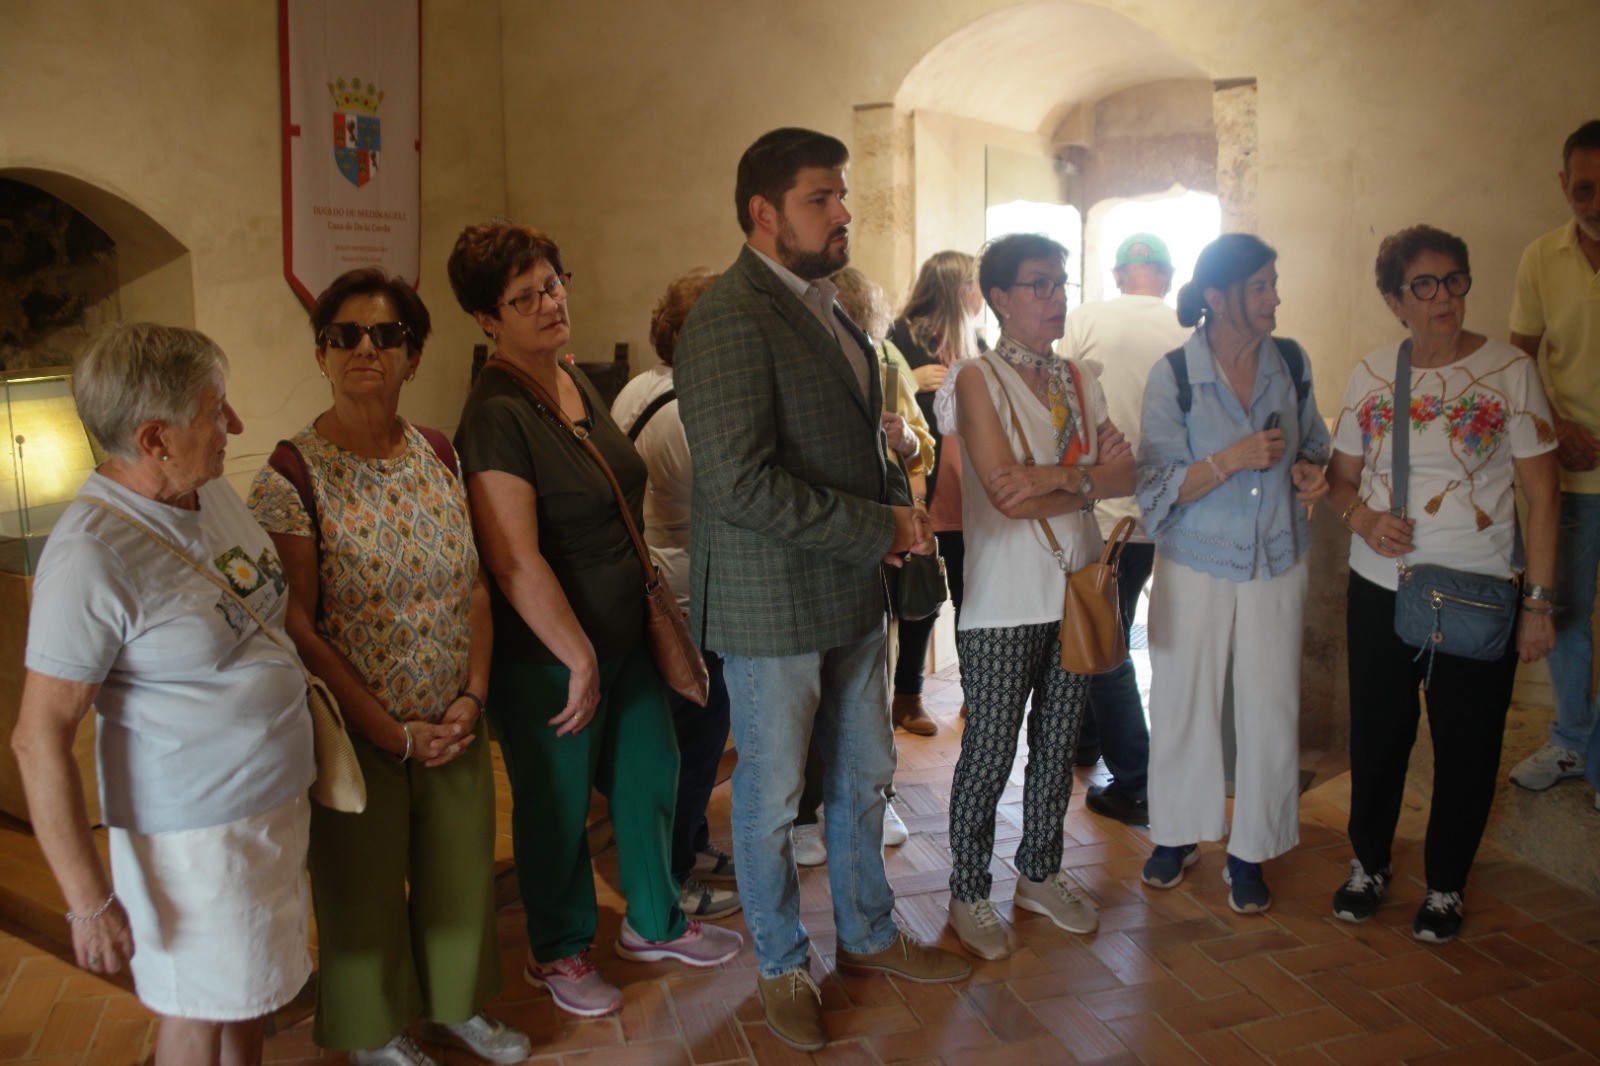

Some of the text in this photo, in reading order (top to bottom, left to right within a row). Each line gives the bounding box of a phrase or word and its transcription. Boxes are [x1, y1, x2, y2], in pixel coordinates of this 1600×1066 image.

[313, 206, 405, 220] DUCADO DE MEDINACELI
[327, 221, 391, 232] Casa de De la Cerda
